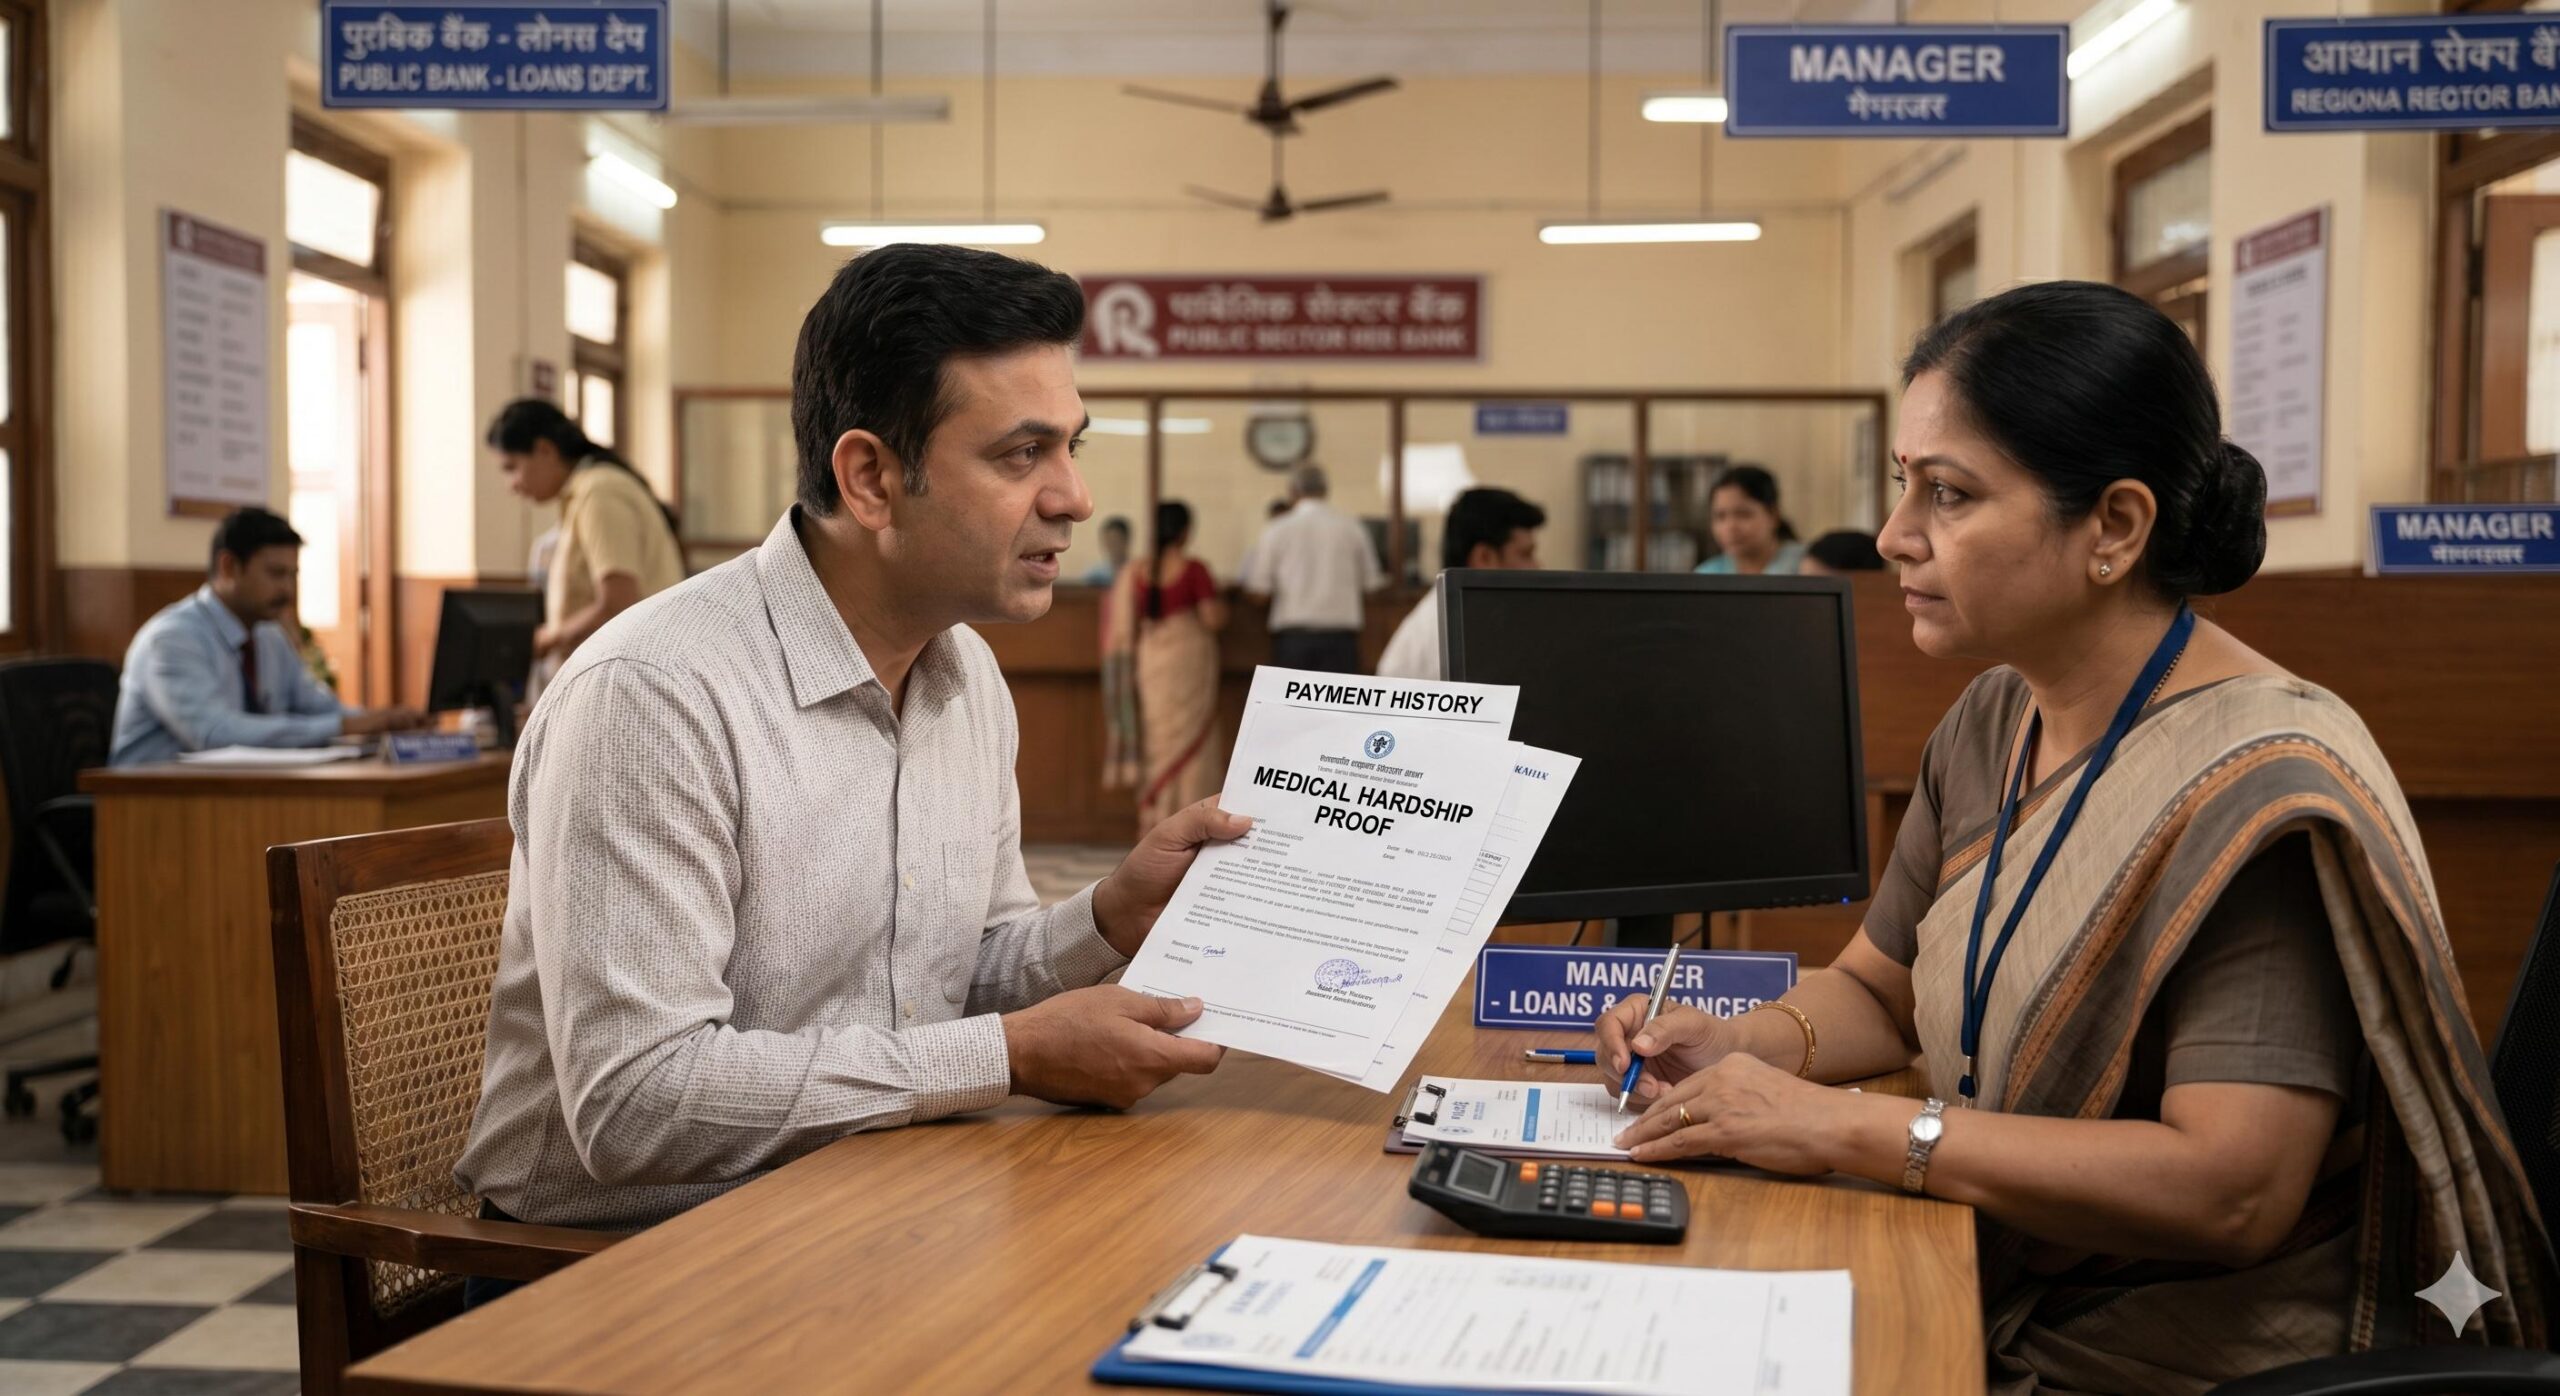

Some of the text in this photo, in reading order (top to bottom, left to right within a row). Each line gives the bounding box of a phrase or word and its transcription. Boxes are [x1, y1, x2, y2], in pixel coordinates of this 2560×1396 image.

[339, 63, 421, 91] PUBLIC
[426, 63, 490, 92] BANK
[507, 63, 586, 93] LOANS
[588, 64, 651, 93] DEPT.
[1790, 45, 2004, 83] MANAGER
[2291, 87, 2403, 114] REGIONA
[2407, 84, 2511, 112] RECTOR
[2396, 512, 2554, 540] MANAGER
[1285, 681, 1484, 714] PAYMENT HISTORY
[1253, 766, 1351, 803] MEDICAL
[1357, 786, 1474, 824] HARDSHIP
[1314, 804, 1395, 837] PROOF
[1509, 990, 1593, 1017] LOANS
